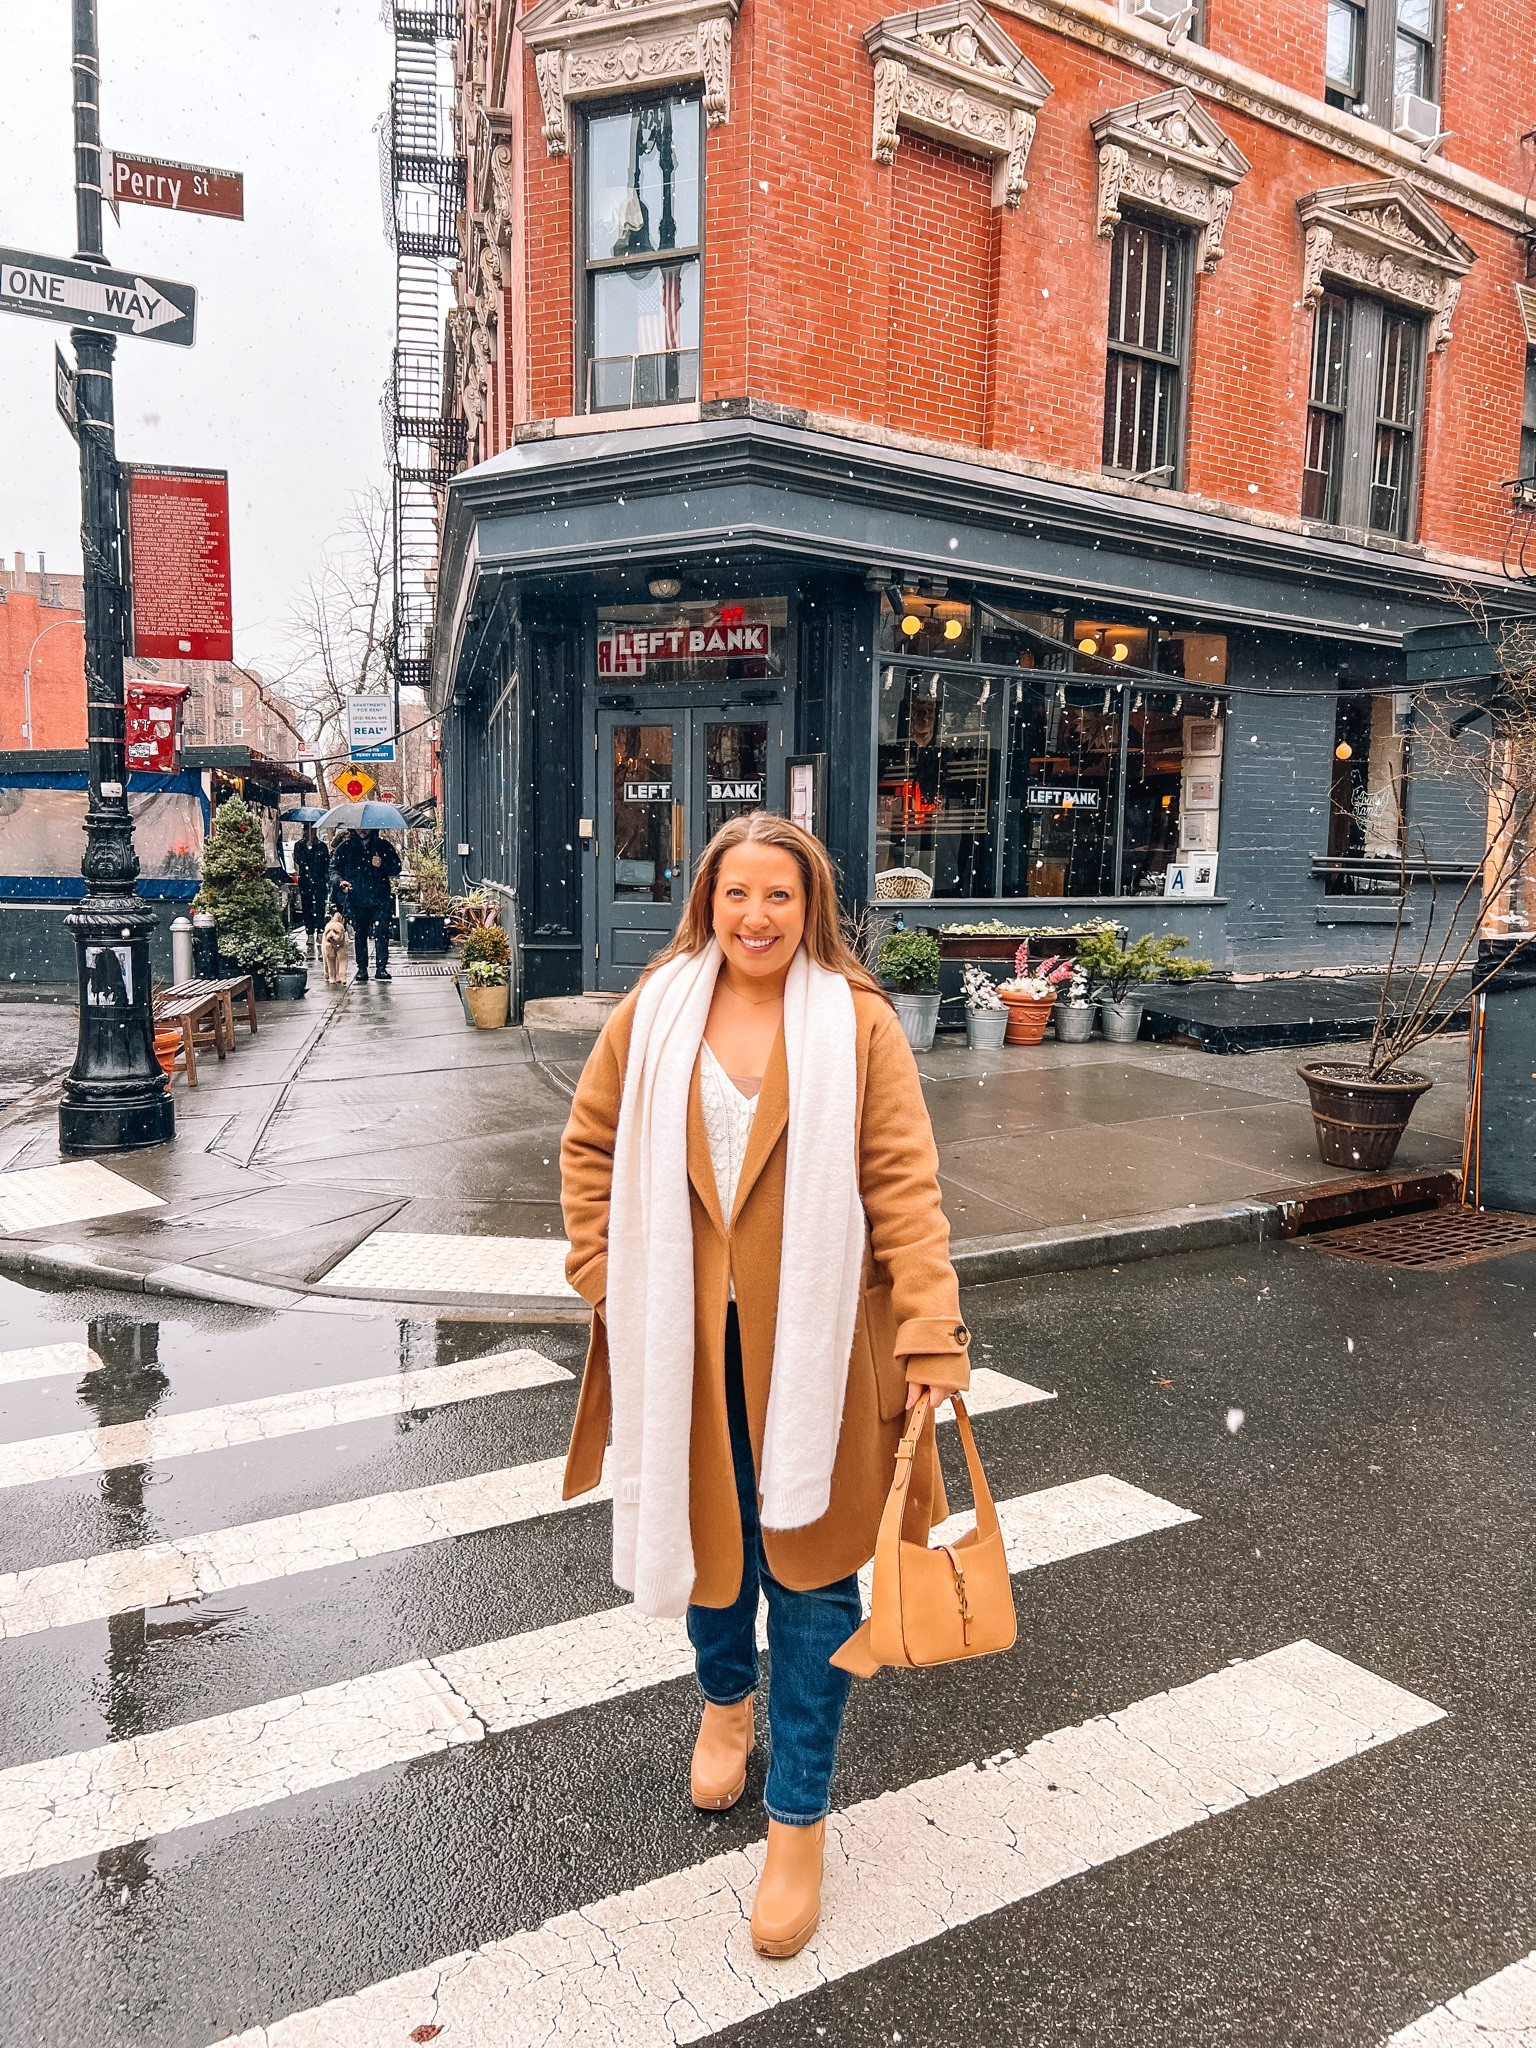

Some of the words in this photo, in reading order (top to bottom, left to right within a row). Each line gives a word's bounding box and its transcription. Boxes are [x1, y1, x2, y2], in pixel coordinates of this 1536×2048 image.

[117, 162, 181, 209] Perry
[193, 176, 208, 196] St
[9, 270, 65, 302] ONE
[105, 288, 161, 320] WAY
[619, 631, 684, 655] LEFT
[689, 627, 764, 653] BANK
[628, 785, 670, 799] LEFT
[711, 783, 758, 799] BANK
[1030, 790, 1061, 804] LEFT
[1063, 791, 1097, 805] BANK
[1172, 869, 1184, 889] A
